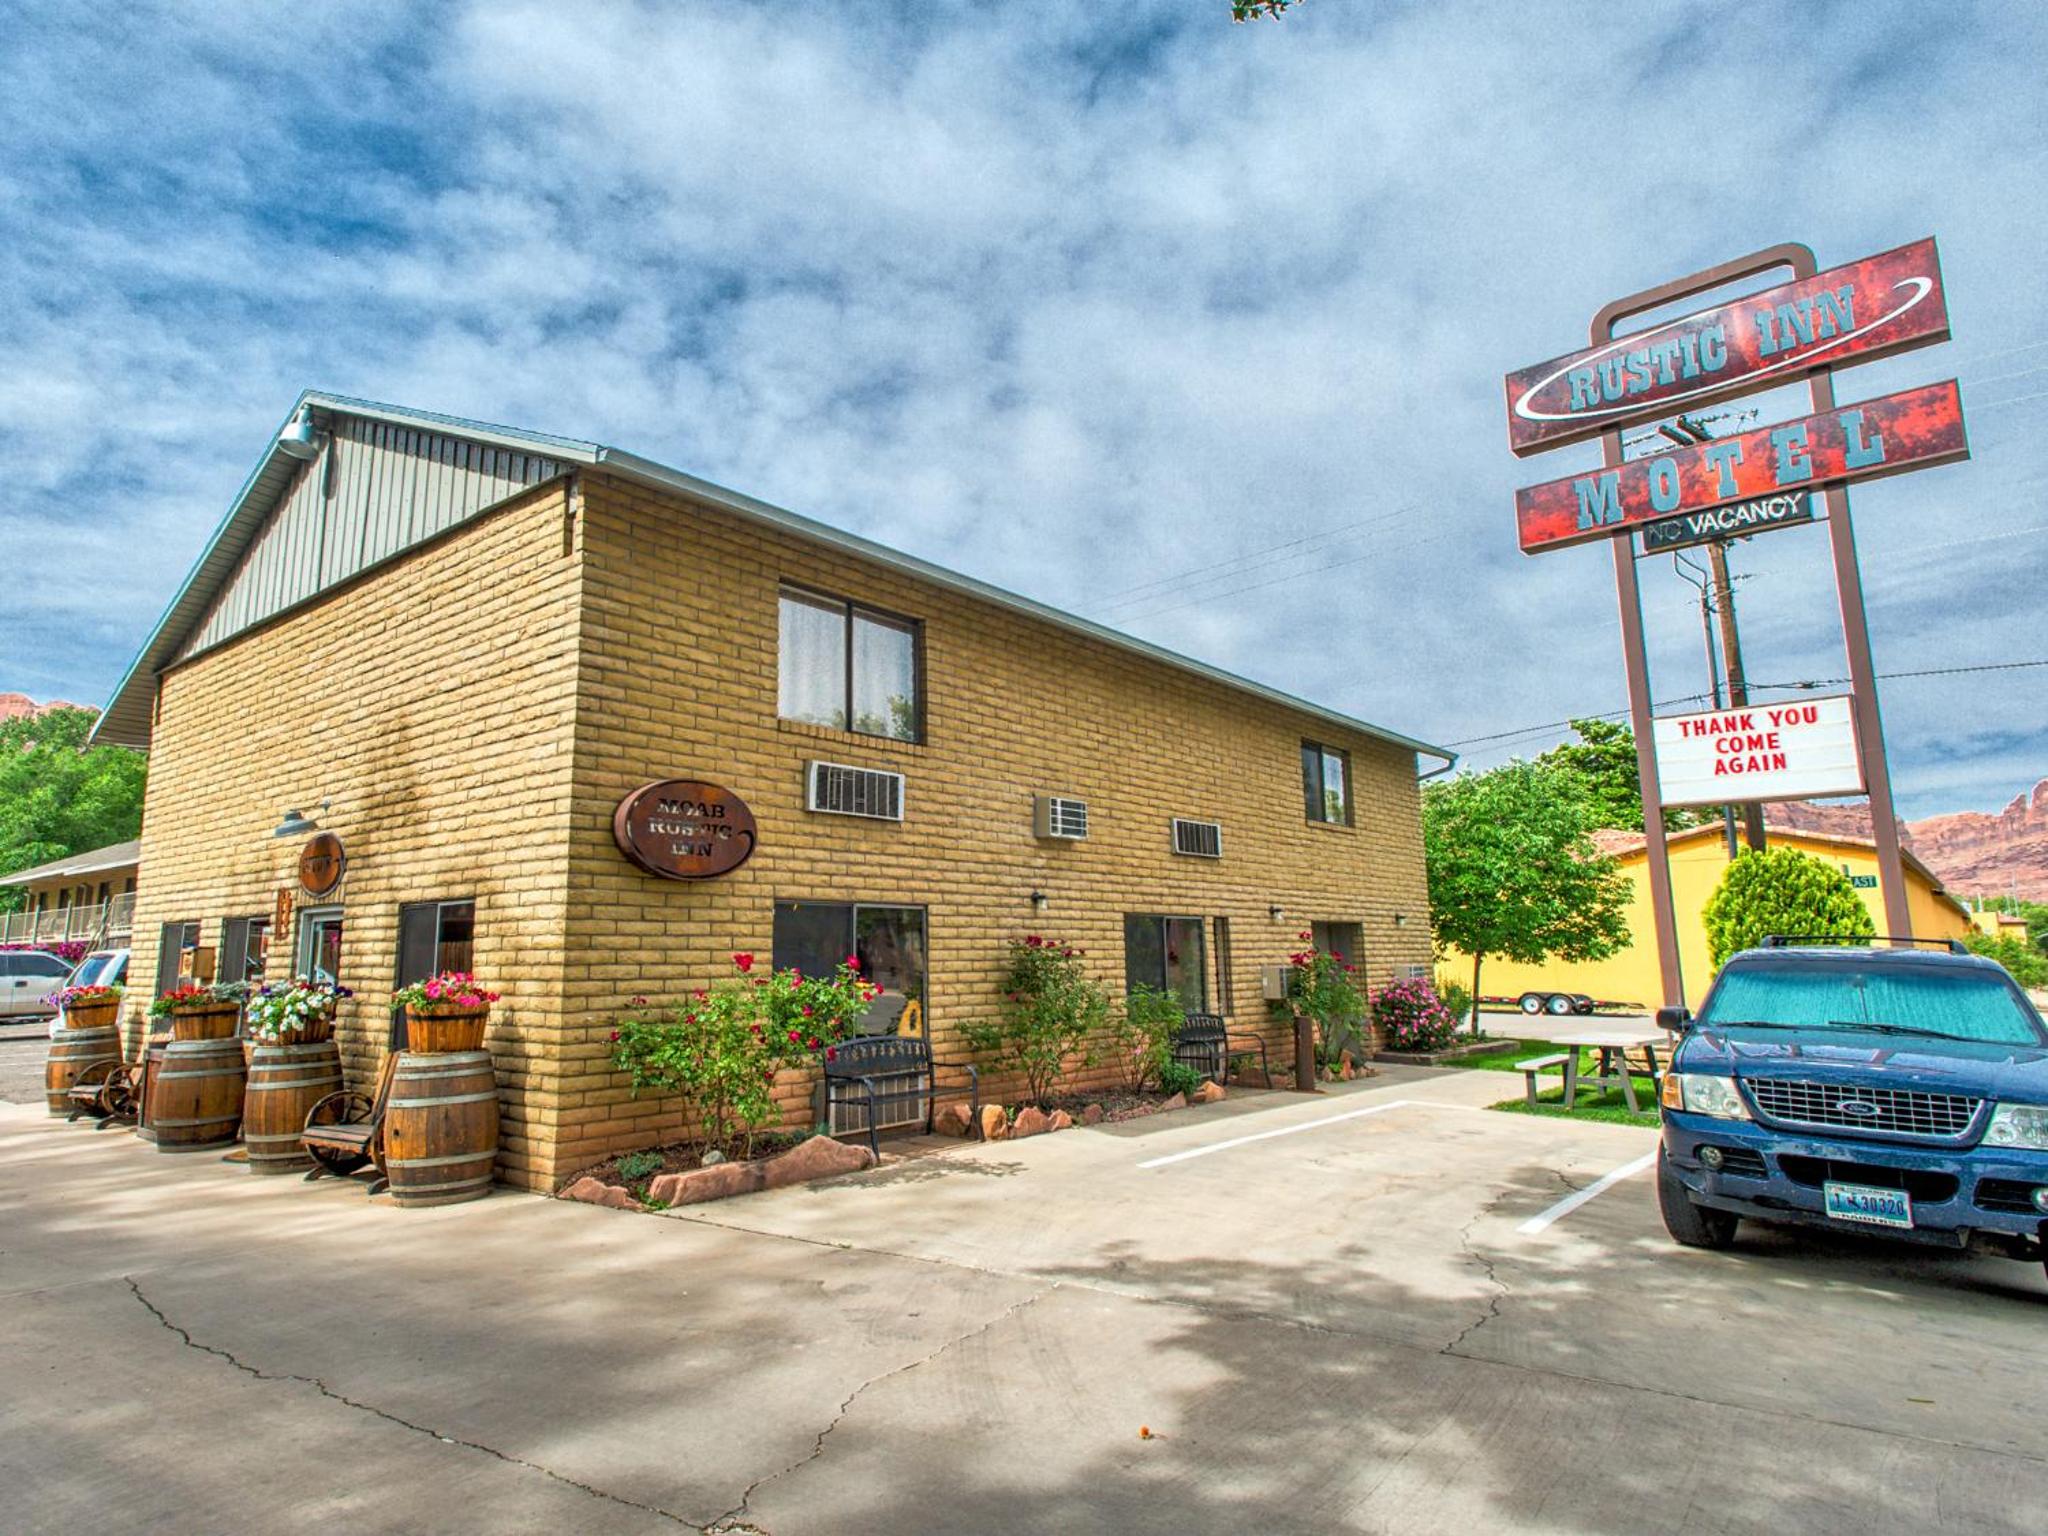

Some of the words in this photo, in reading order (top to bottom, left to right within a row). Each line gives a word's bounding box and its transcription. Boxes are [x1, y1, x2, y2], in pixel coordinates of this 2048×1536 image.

[1568, 324, 1728, 411] RUSTIC
[1755, 284, 1856, 358] INN
[1573, 409, 1886, 530] MOTEL
[1649, 520, 1683, 541] NO
[1686, 492, 1804, 536] VACANCY
[1678, 714, 1755, 738] THANK
[1767, 705, 1819, 728] YOU
[1716, 732, 1780, 755] COME
[1714, 752, 1788, 776] AGAIN
[657, 798, 726, 819] MOAB
[1852, 876, 1875, 888] AST
[1861, 1195, 1904, 1216] 30320
